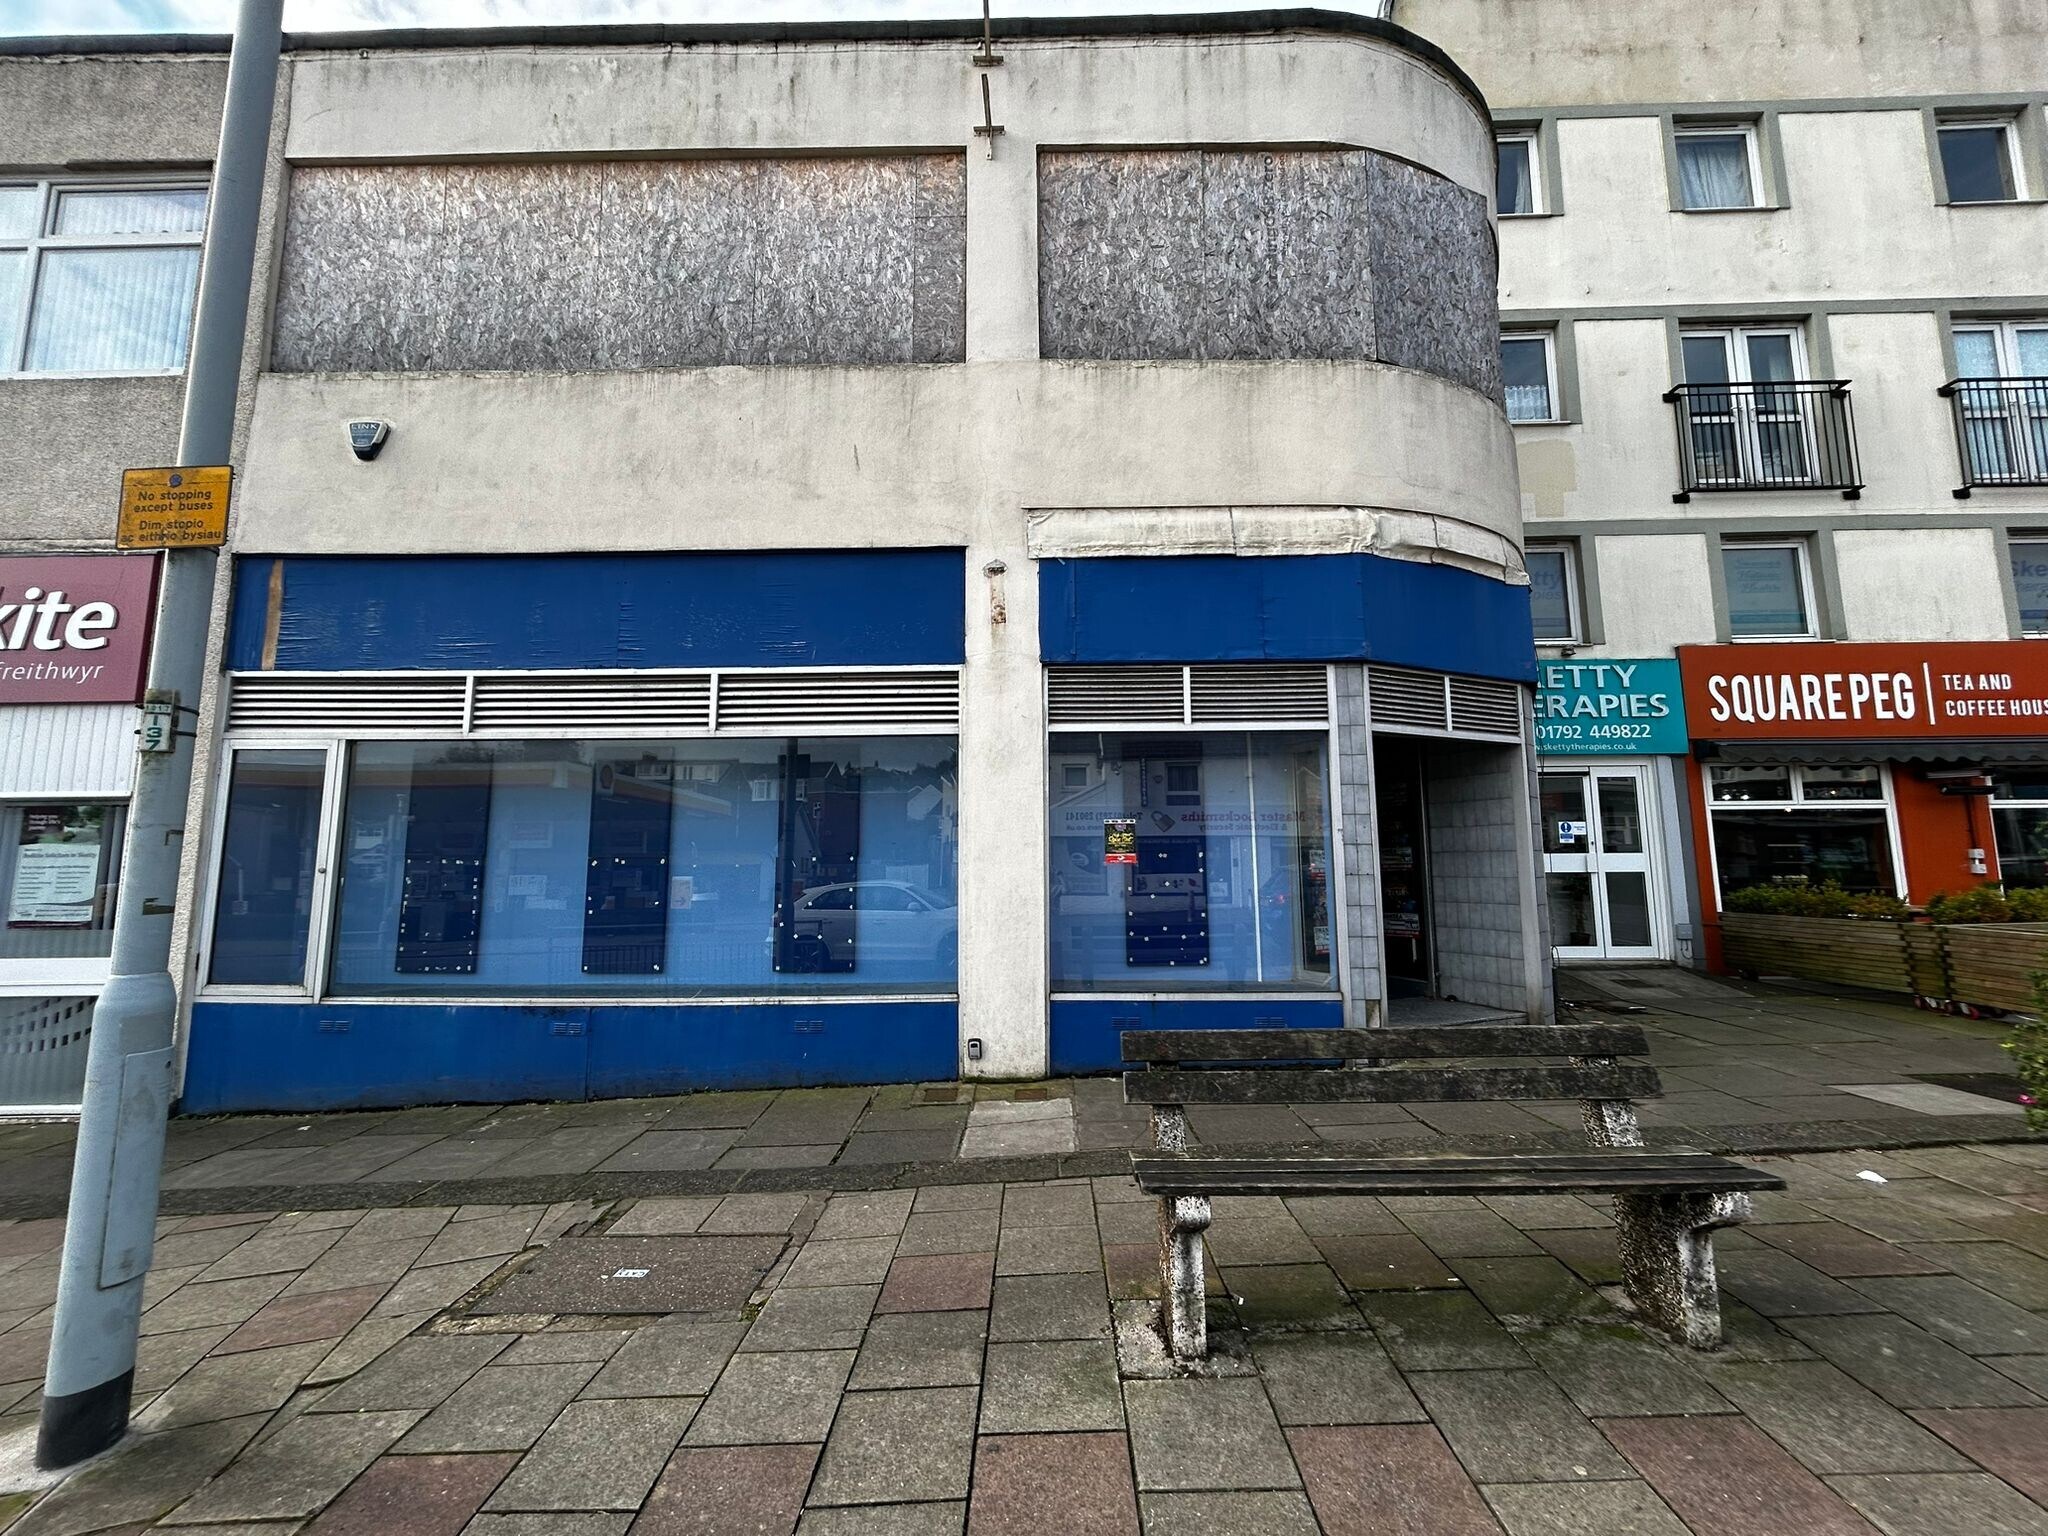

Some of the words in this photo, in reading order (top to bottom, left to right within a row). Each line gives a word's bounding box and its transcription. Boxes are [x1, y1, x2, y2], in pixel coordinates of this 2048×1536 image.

[138, 491, 154, 501] No
[160, 489, 212, 501] stopping
[134, 501, 173, 513] except
[179, 501, 214, 511] buses
[139, 520, 161, 530] Dim
[167, 519, 204, 530] stopio
[121, 534, 134, 543] ac
[182, 530, 221, 542] bysiau
[1537, 664, 1637, 689] ETTY
[1942, 674, 1974, 691] TEA
[1979, 674, 2012, 690] AND
[1708, 673, 1847, 723] SQUARE
[1848, 672, 1916, 720] PEG
[1945, 699, 2007, 717] COFFEE
[1536, 725, 1583, 739] 01792
[1589, 724, 1652, 739] 449822
